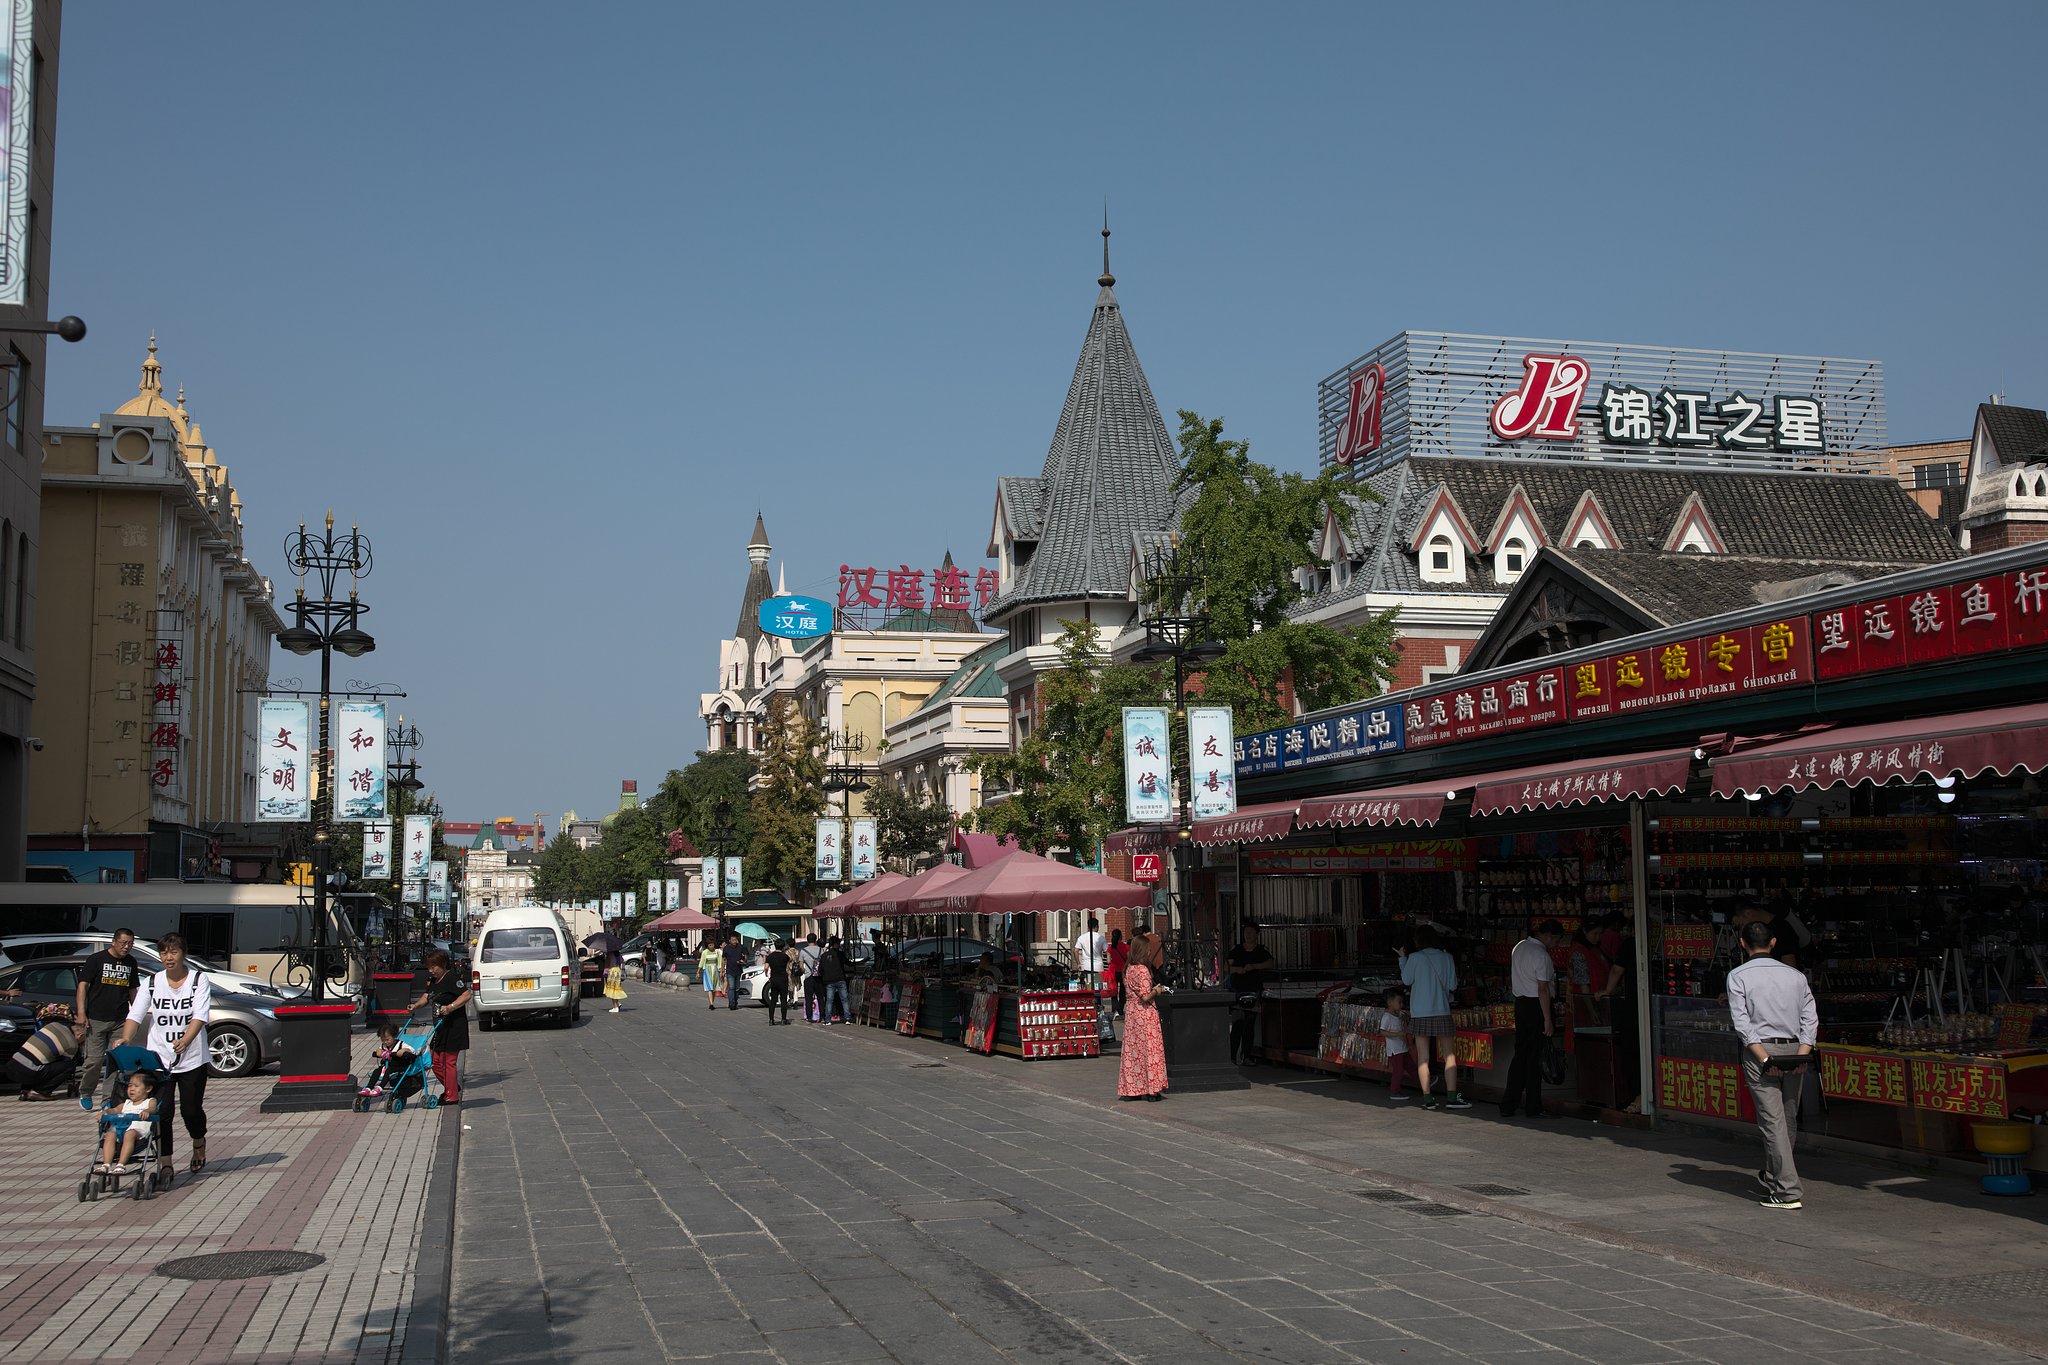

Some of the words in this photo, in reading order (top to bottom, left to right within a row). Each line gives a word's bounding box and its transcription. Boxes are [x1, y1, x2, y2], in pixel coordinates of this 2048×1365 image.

[1603, 388, 1824, 449] 锦江之星
[776, 616, 818, 630] 汉庭
[1821, 571, 2048, 654] 望远镜鱼杆
[1575, 623, 1795, 700] 望远镜专营
[1406, 673, 1559, 732] 亮亮精品商行
[1689, 681, 1736, 701] продажи
[1233, 733, 1279, 762] 品名店
[1284, 709, 1391, 754] 海悦精品
[271, 727, 298, 792] 文明
[348, 727, 375, 793] 和谐
[1135, 735, 1160, 794] 诚信
[1203, 735, 1224, 792] 友善
[1787, 742, 1945, 780] 大连·俄罗斯风情街
[371, 828, 385, 864] 自由
[410, 830, 424, 865] 平等
[823, 833, 836, 866] 爱国
[858, 834, 871, 866] 敬业
[706, 866, 716, 889] 公正
[1665, 927, 1711, 941] 批发望远镜
[1667, 945, 1711, 956] 28元/台
[102, 970, 131, 980] SWEAT
[103, 962, 132, 974] BLOOD
[157, 1013, 193, 1026] GIVE
[1661, 1058, 1738, 1119] 望远镜专营
[1824, 1054, 1905, 1102] 批发套娃
[1913, 1061, 2005, 1101] 批发巧克力
[1916, 1094, 2004, 1118] 10元3盒
